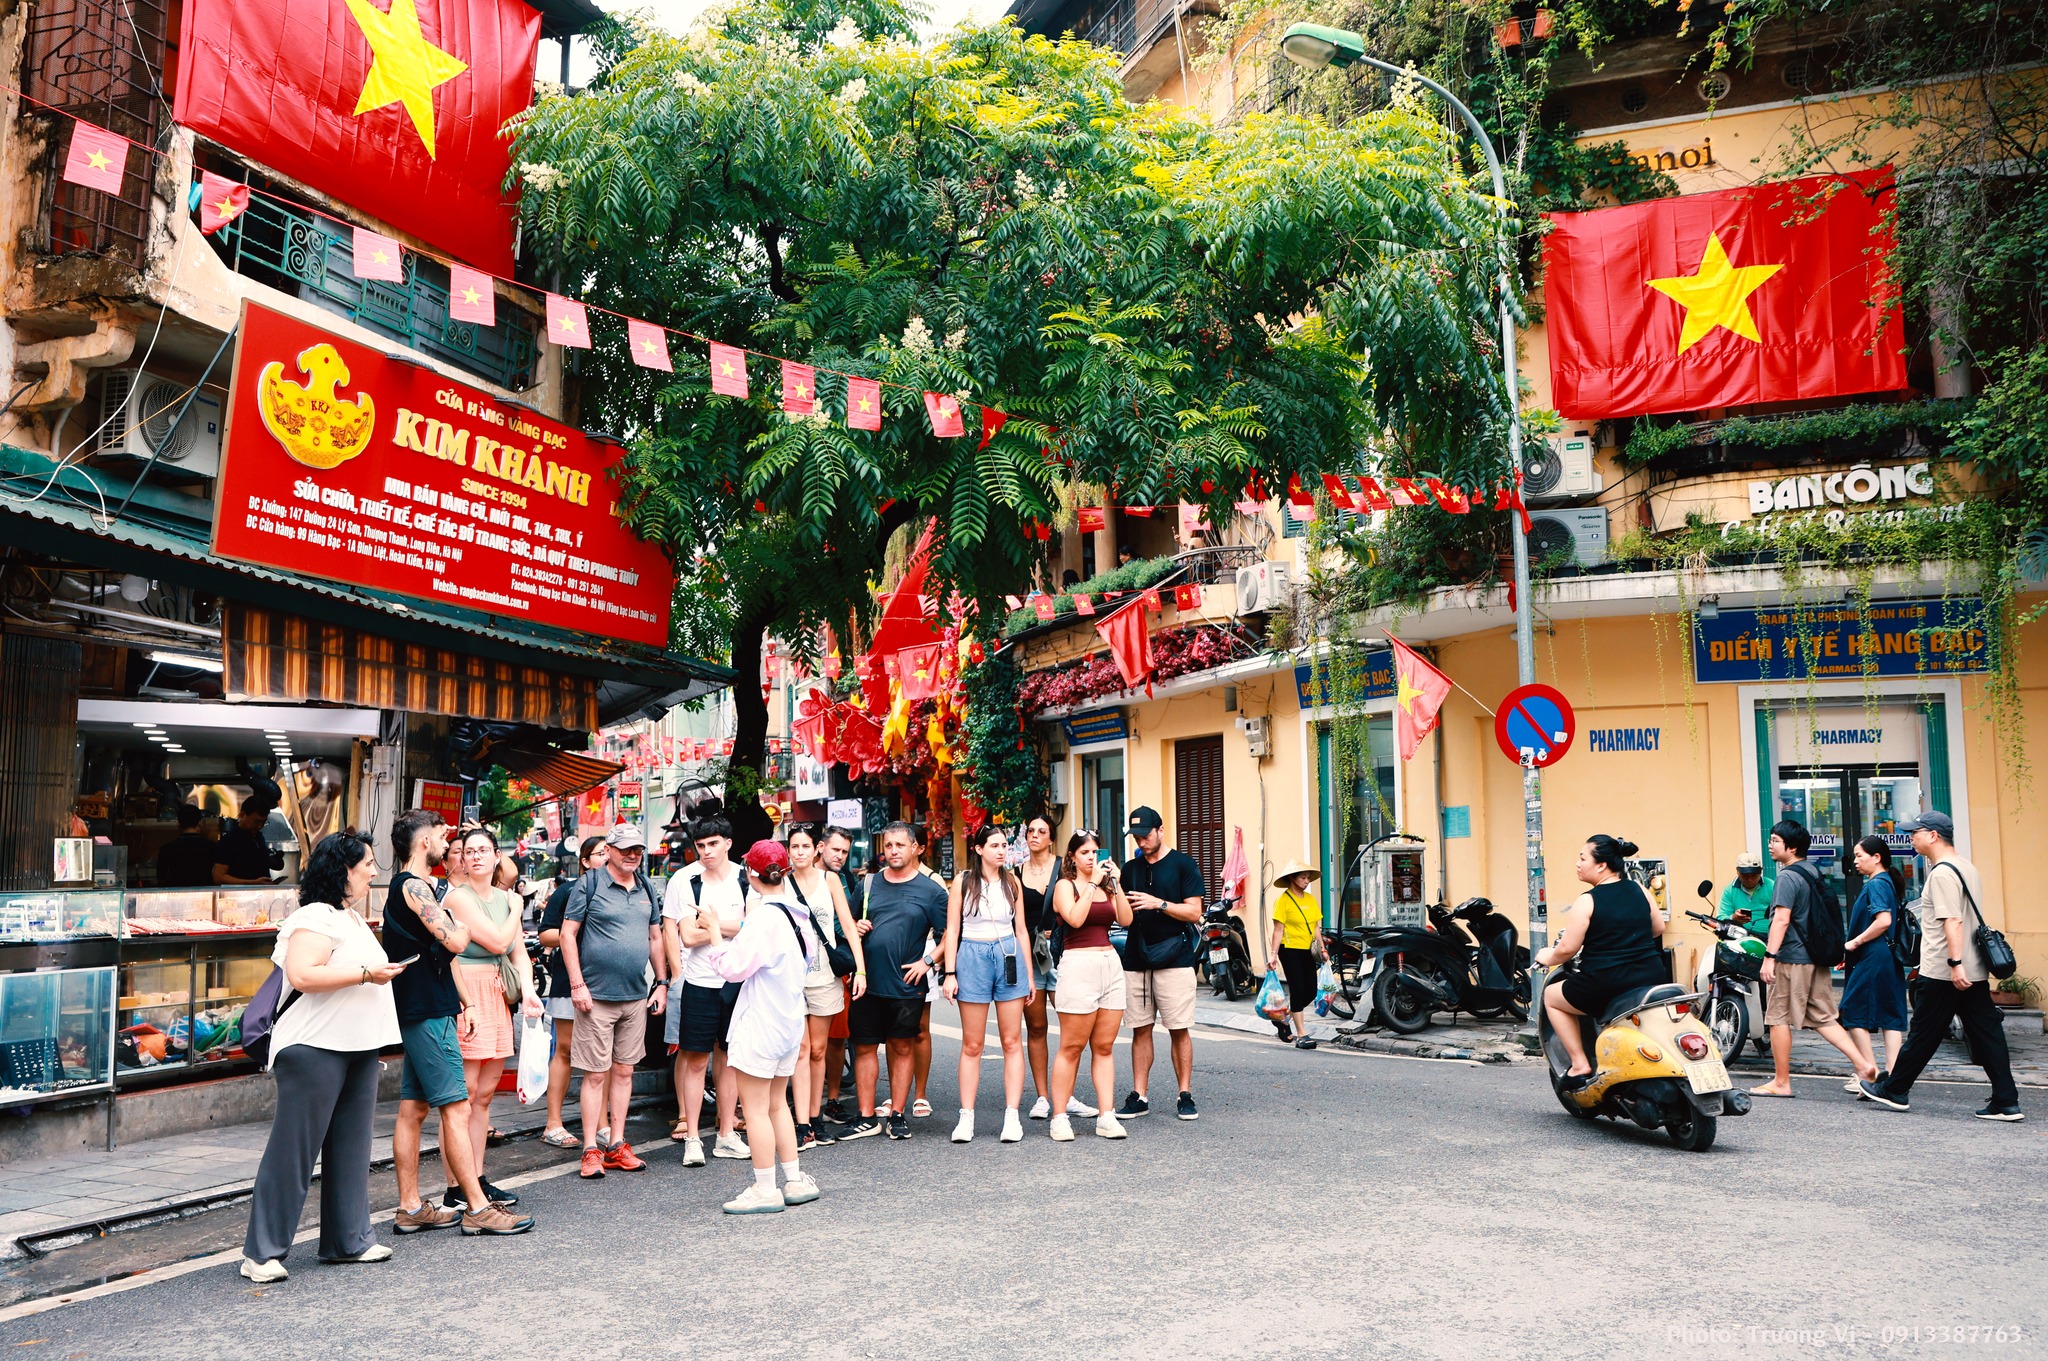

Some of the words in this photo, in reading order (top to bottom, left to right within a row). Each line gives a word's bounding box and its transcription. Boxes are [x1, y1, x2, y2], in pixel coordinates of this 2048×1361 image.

[1634, 136, 1717, 172] anoi
[435, 388, 463, 413] CỬA
[467, 401, 505, 427] HÀNG
[508, 416, 540, 440] VÀNG
[543, 430, 568, 450] BẠC
[392, 408, 470, 466] KIM
[472, 435, 591, 507] KHÁNH
[461, 477, 499, 501] SINCE
[500, 490, 528, 510] 1994
[1748, 463, 1934, 514] BANCÔNG
[248, 495, 260, 510] ĐC
[261, 498, 287, 518] Xưởng:
[289, 505, 304, 522] 147
[304, 509, 326, 530] Đường
[327, 515, 338, 531] 24
[337, 517, 347, 534] Lý
[388, 530, 410, 549] Thanh,
[410, 537, 426, 553] Long
[426, 541, 442, 558] Biên,
[443, 545, 451, 557] Hà
[451, 548, 463, 563] Nội
[384, 476, 411, 499] MUA
[413, 484, 438, 507] BÁN
[440, 492, 470, 516] VÀNG
[470, 502, 488, 523] CŨ,
[489, 507, 511, 528] MỚI
[512, 515, 533, 536] 10K,
[534, 521, 553, 542] 14K,
[555, 527, 574, 548] 18K,
[576, 531, 584, 548] Ý
[246, 514, 258, 530] ĐC
[259, 517, 274, 534] Cửa
[275, 521, 296, 540] hàng:
[297, 527, 307, 541] 99
[308, 529, 326, 547] Hàng
[327, 533, 341, 551] Bạc
[347, 539, 357, 554] 1A
[388, 548, 405, 565] Hoàn
[425, 558, 434, 571] Hà
[435, 561, 446, 576] Nội
[293, 476, 320, 502] SỬA
[321, 487, 358, 515] CHỮA,
[360, 497, 394, 521] THIẾT
[393, 505, 413, 530] KẾ,
[413, 512, 439, 533] CHẾ
[438, 517, 458, 539] TÁC
[458, 523, 476, 543] ĐỒ
[476, 529, 511, 553] TRANG
[510, 538, 533, 561] SỨC,
[533, 544, 547, 563] ĐÁ
[548, 549, 567, 568] QUÝ
[568, 555, 590, 574] THEO
[590, 562, 618, 583] PHONG
[618, 567, 640, 587] THỦY
[433, 578, 458, 595] Website:
[1710, 631, 1773, 662] ĐIỂM
[1784, 638, 1799, 659] Y
[1809, 629, 1839, 658] TẾ
[1848, 629, 1921, 656] HÀNG
[1930, 629, 1984, 656] BẠC
[1372, 669, 1391, 688] BẠC
[1589, 728, 1660, 752] PHARMACY
[1813, 729, 1883, 745] PHARMACY
[1809, 834, 1836, 844] MACY
